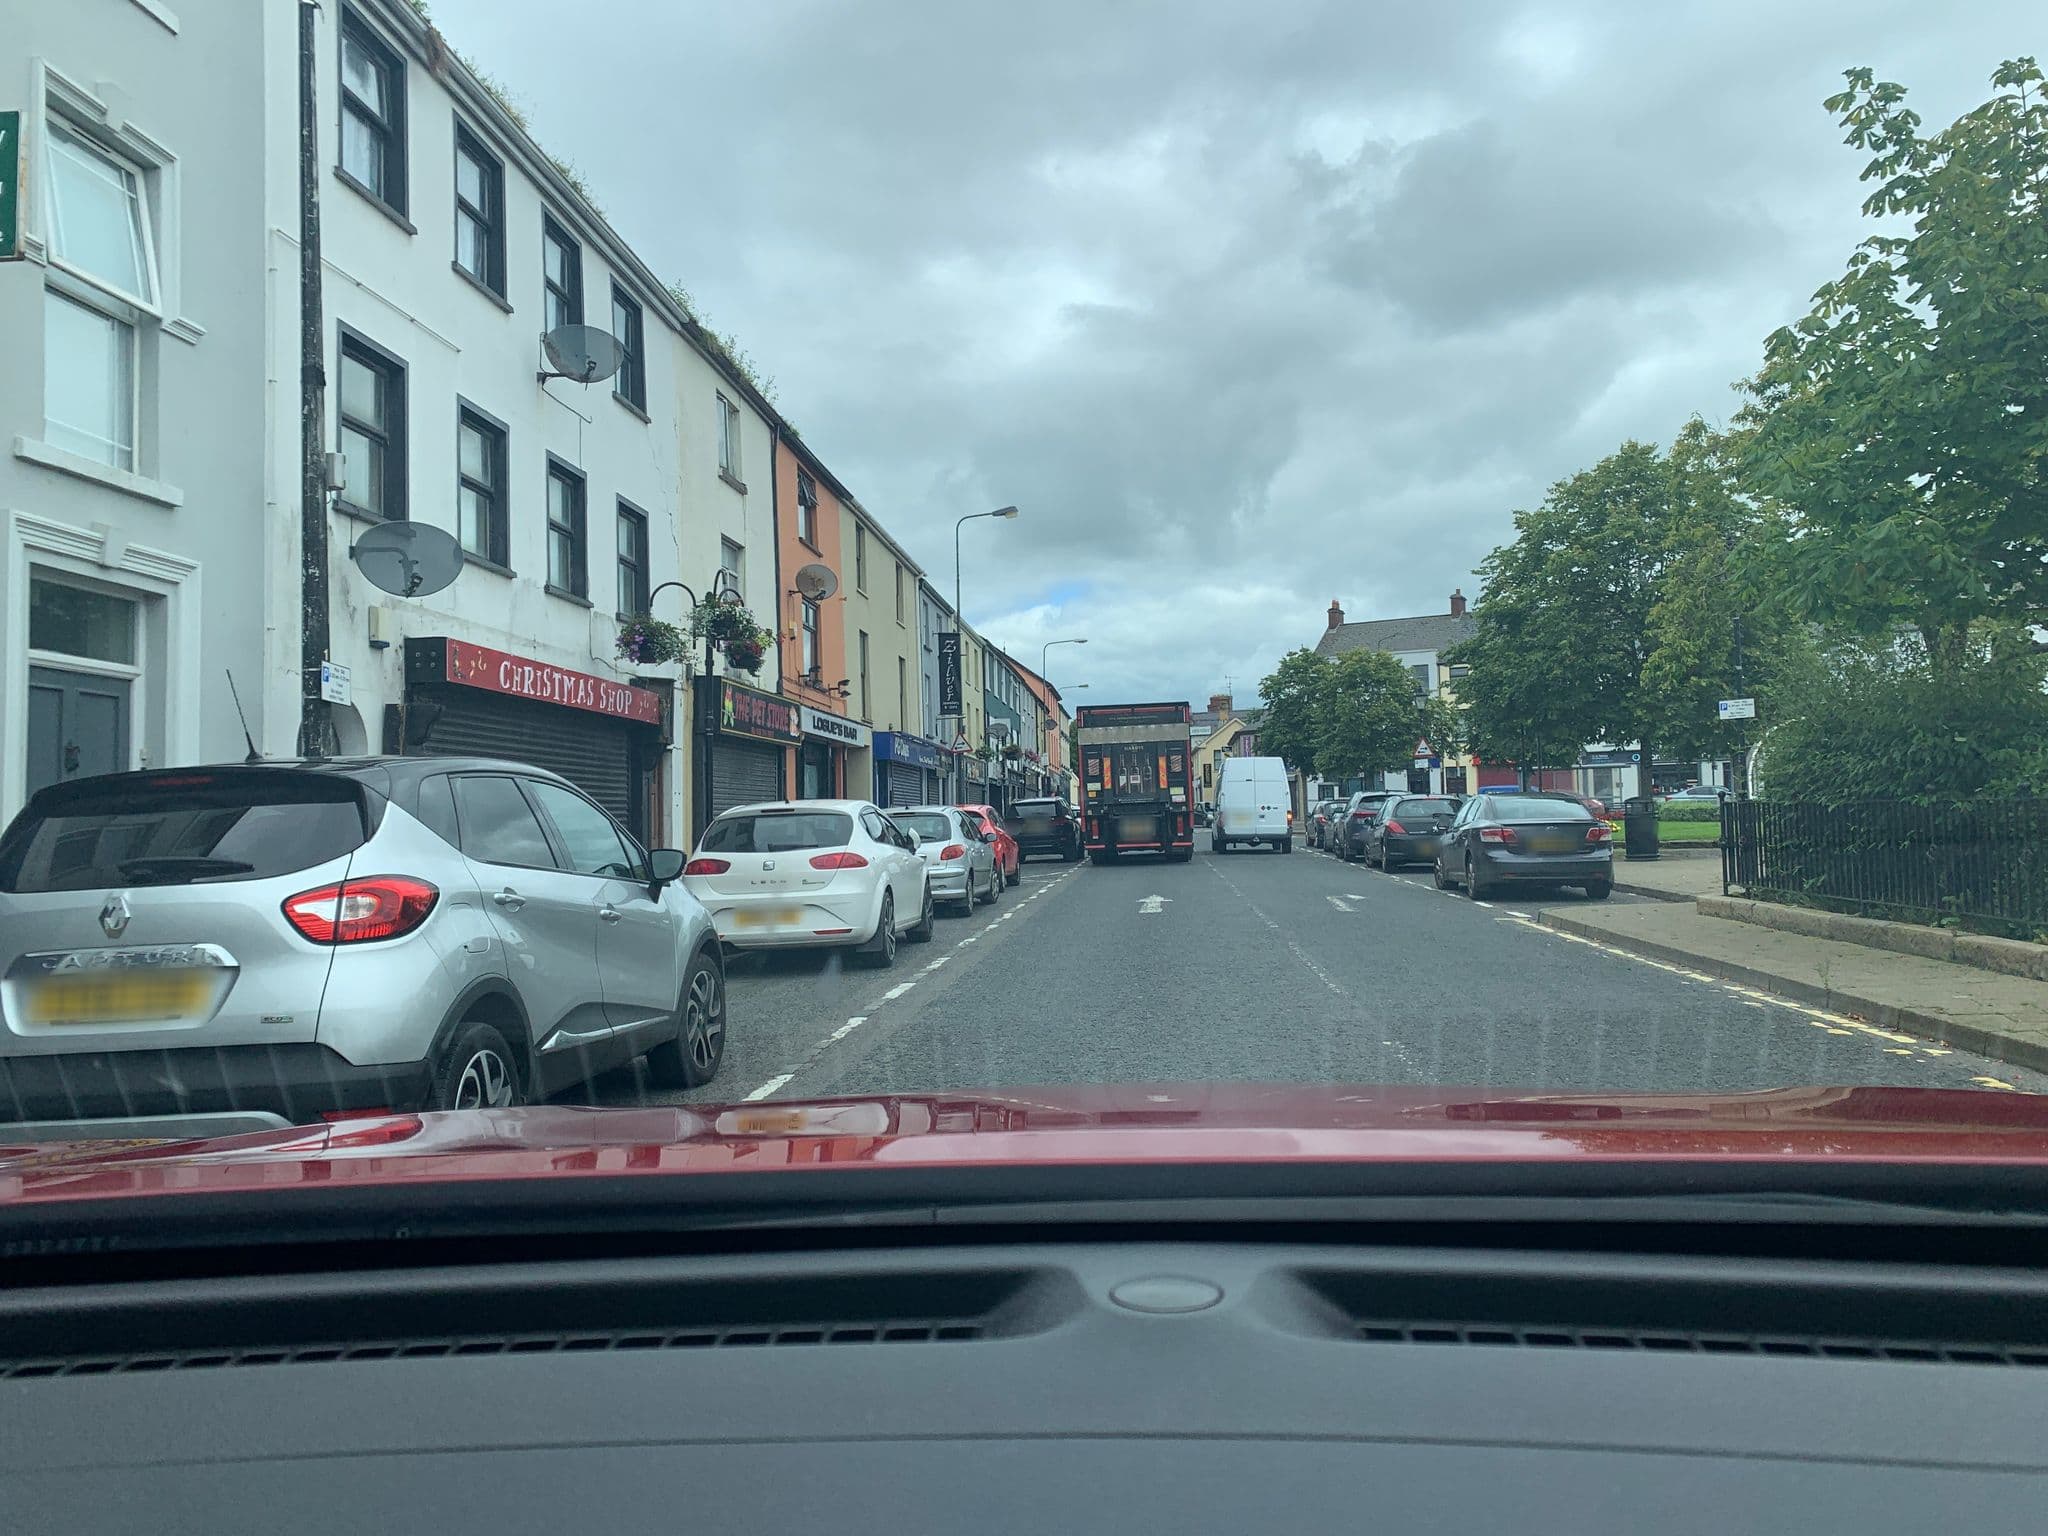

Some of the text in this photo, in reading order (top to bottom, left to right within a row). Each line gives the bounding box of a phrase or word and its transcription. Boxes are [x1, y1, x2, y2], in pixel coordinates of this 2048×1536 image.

[943, 640, 957, 701] Zilver
[735, 692, 789, 732] THE PET STORE
[812, 715, 858, 740] LOGUE'S BAR
[42, 949, 190, 969] CAPTUR
